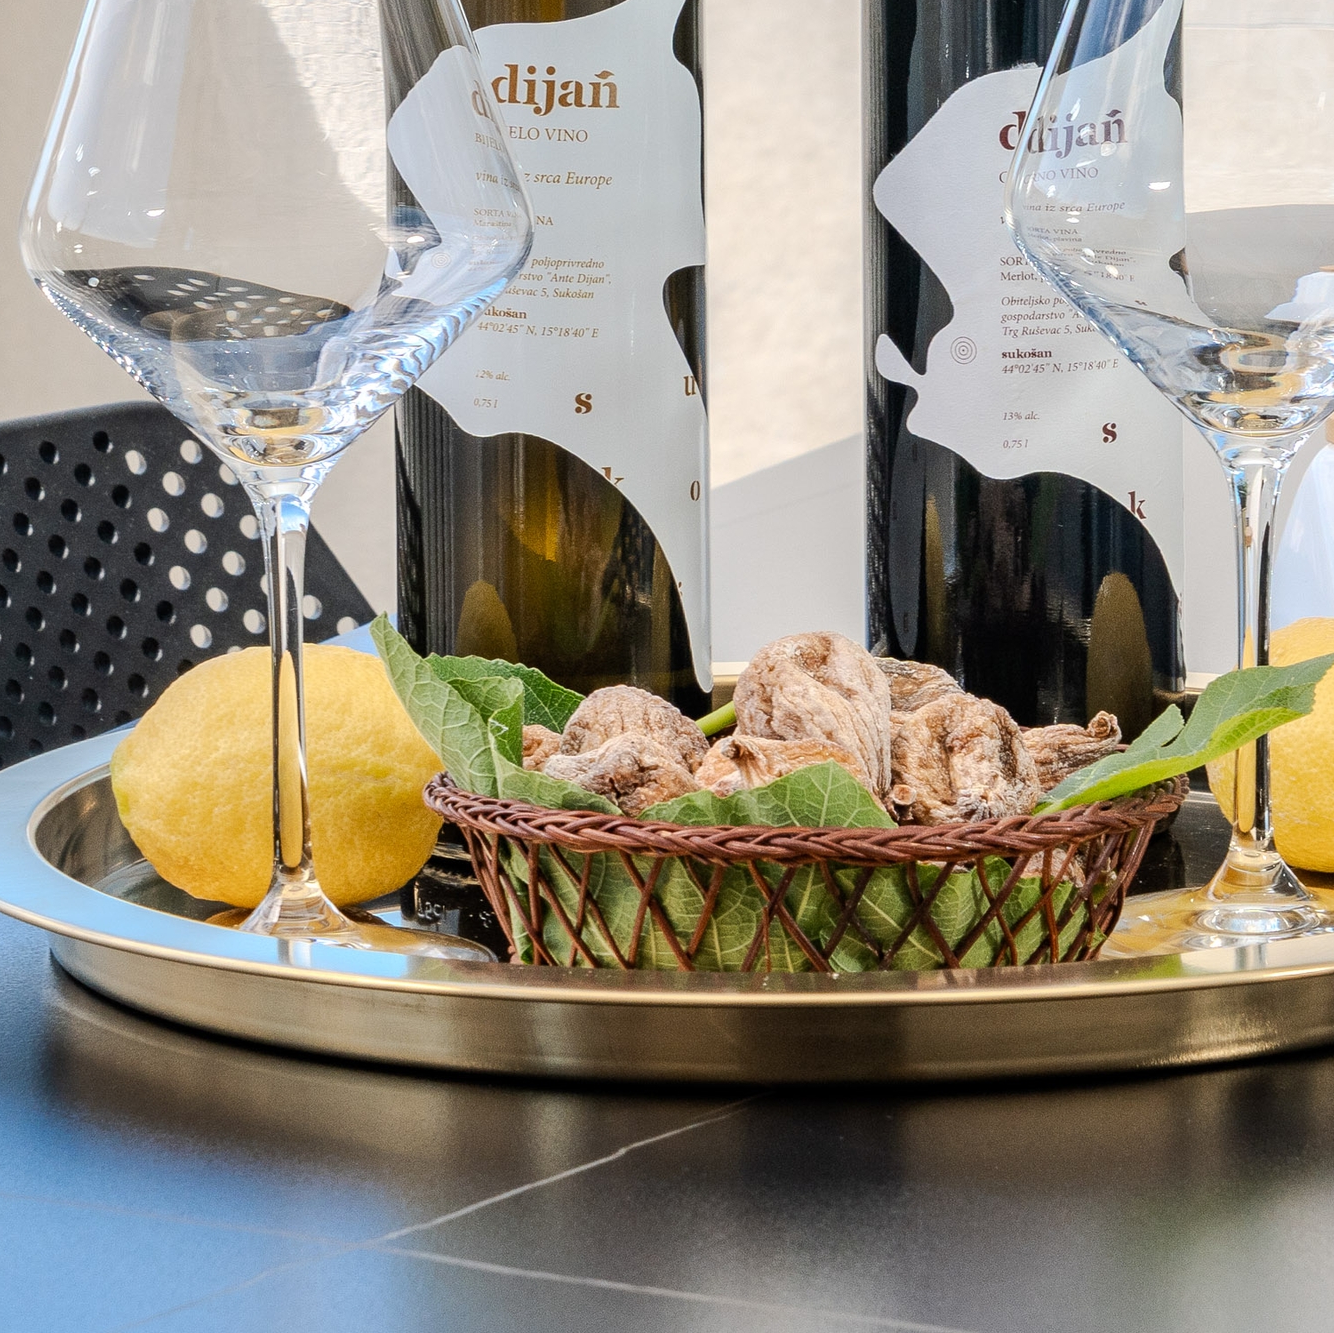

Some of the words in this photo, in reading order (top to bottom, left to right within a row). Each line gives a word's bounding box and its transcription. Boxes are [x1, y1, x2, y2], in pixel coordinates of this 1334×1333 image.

[509, 125, 540, 141] ELO
[545, 128, 588, 143] VINO
[1060, 167, 1099, 180] VINO
[534, 173, 561, 184] srca
[565, 171, 613, 190] Europe
[1087, 202, 1126, 213] Europe
[536, 215, 554, 226] NA
[530, 256, 605, 271] poljoprivredno
[999, 256, 1028, 266] SOR
[1000, 271, 1038, 282] Merlot,
[505, 286, 538, 298] uševac
[552, 287, 595, 300] Sukošan
[1001, 296, 1051, 308] Obiteljsko
[484, 306, 527, 320] ukošan
[1000, 311, 1066, 324] gospodarstvo
[591, 328, 599, 339] E
[1002, 326, 1019, 338] Trg
[1021, 325, 1062, 336] Ruševac
[1001, 348, 1052, 359] sukošan
[1113, 358, 1119, 368] E
[495, 369, 511, 382] alc.
[473, 397, 493, 409] 0,75
[574, 392, 593, 415] s
[1002, 411, 1023, 421] 13%
[1024, 411, 1041, 420] alc.
[1102, 422, 1118, 444] s
[1002, 439, 1023, 449] 0,75
[1127, 490, 1147, 520] k
